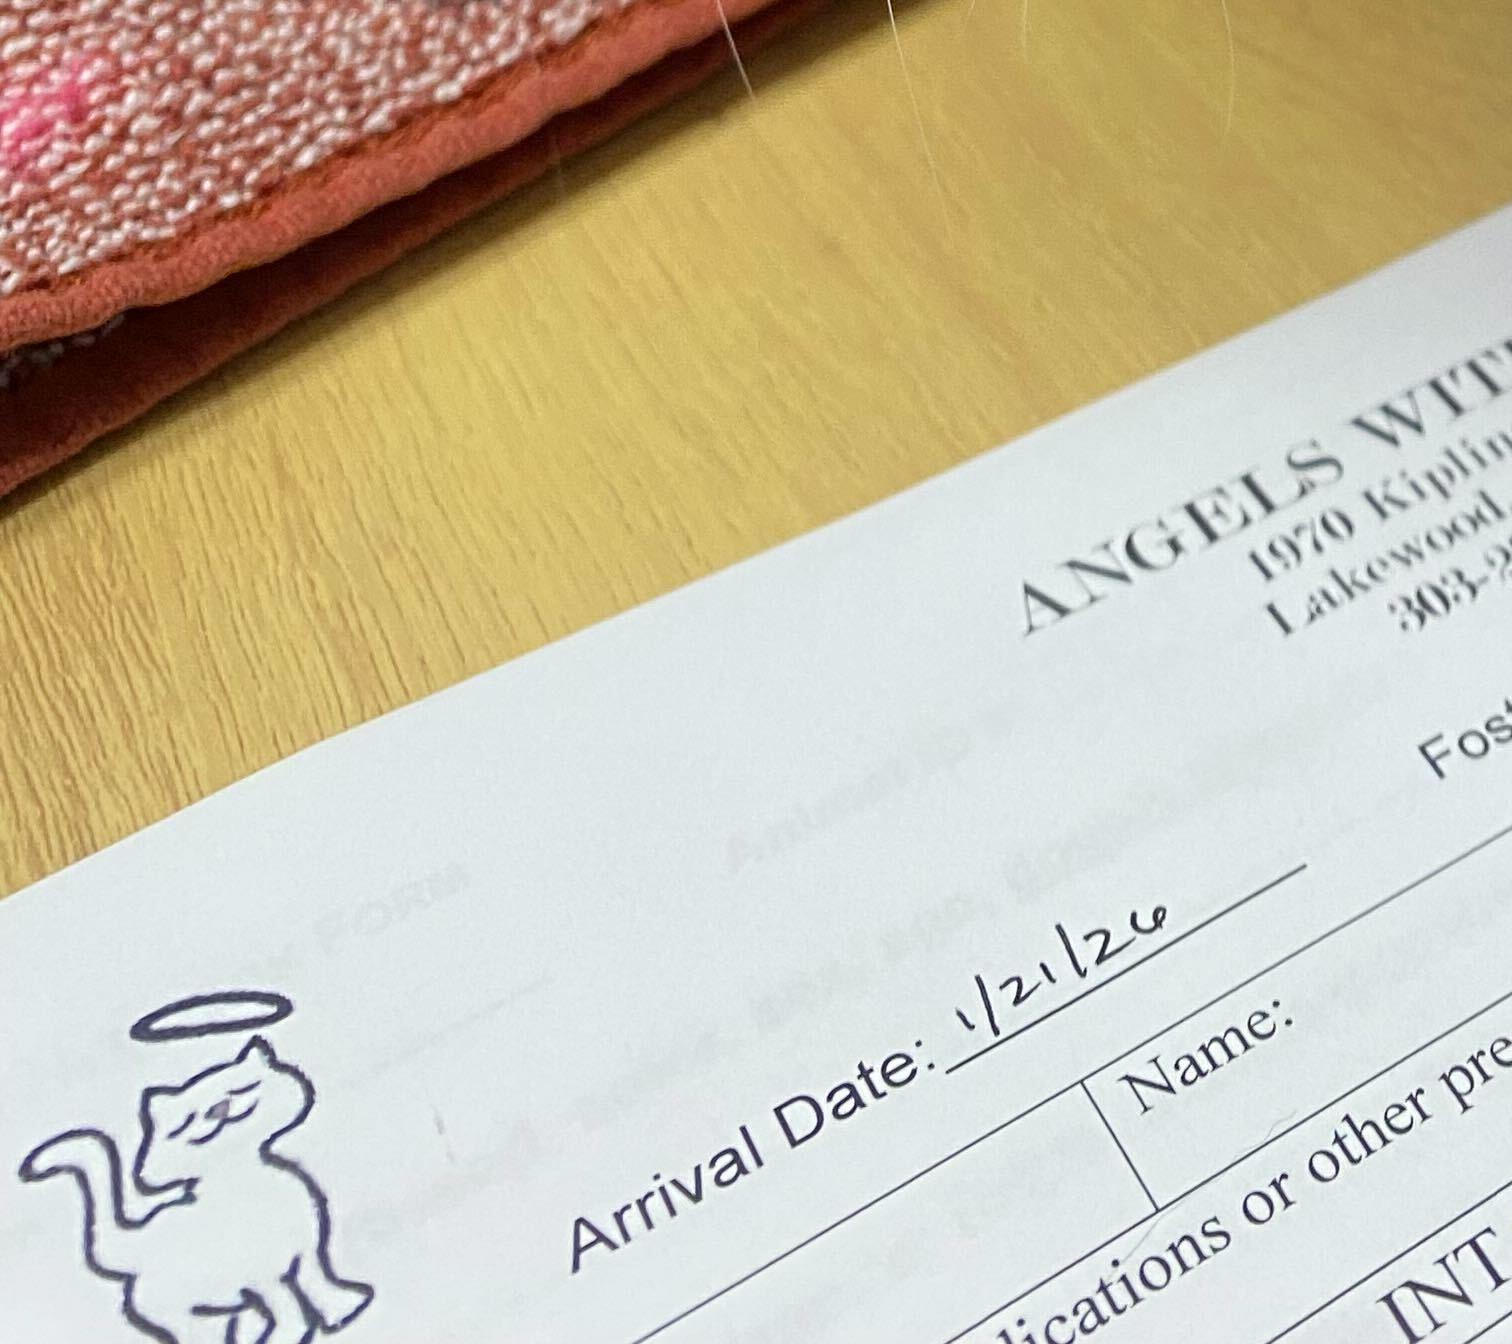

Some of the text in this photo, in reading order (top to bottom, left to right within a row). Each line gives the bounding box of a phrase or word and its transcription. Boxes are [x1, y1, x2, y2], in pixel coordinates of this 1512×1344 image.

[1021, 438, 1345, 638] ANGELS
[1248, 507, 1356, 582] 1970
[956, 904, 1167, 1036] 1/21/26
[1118, 997, 1292, 1115] Name:
[568, 1125, 765, 1275] Arrival
[773, 1039, 937, 1149] Date:
[1242, 1172, 1297, 1225] or
[1308, 1085, 1427, 1186] other
